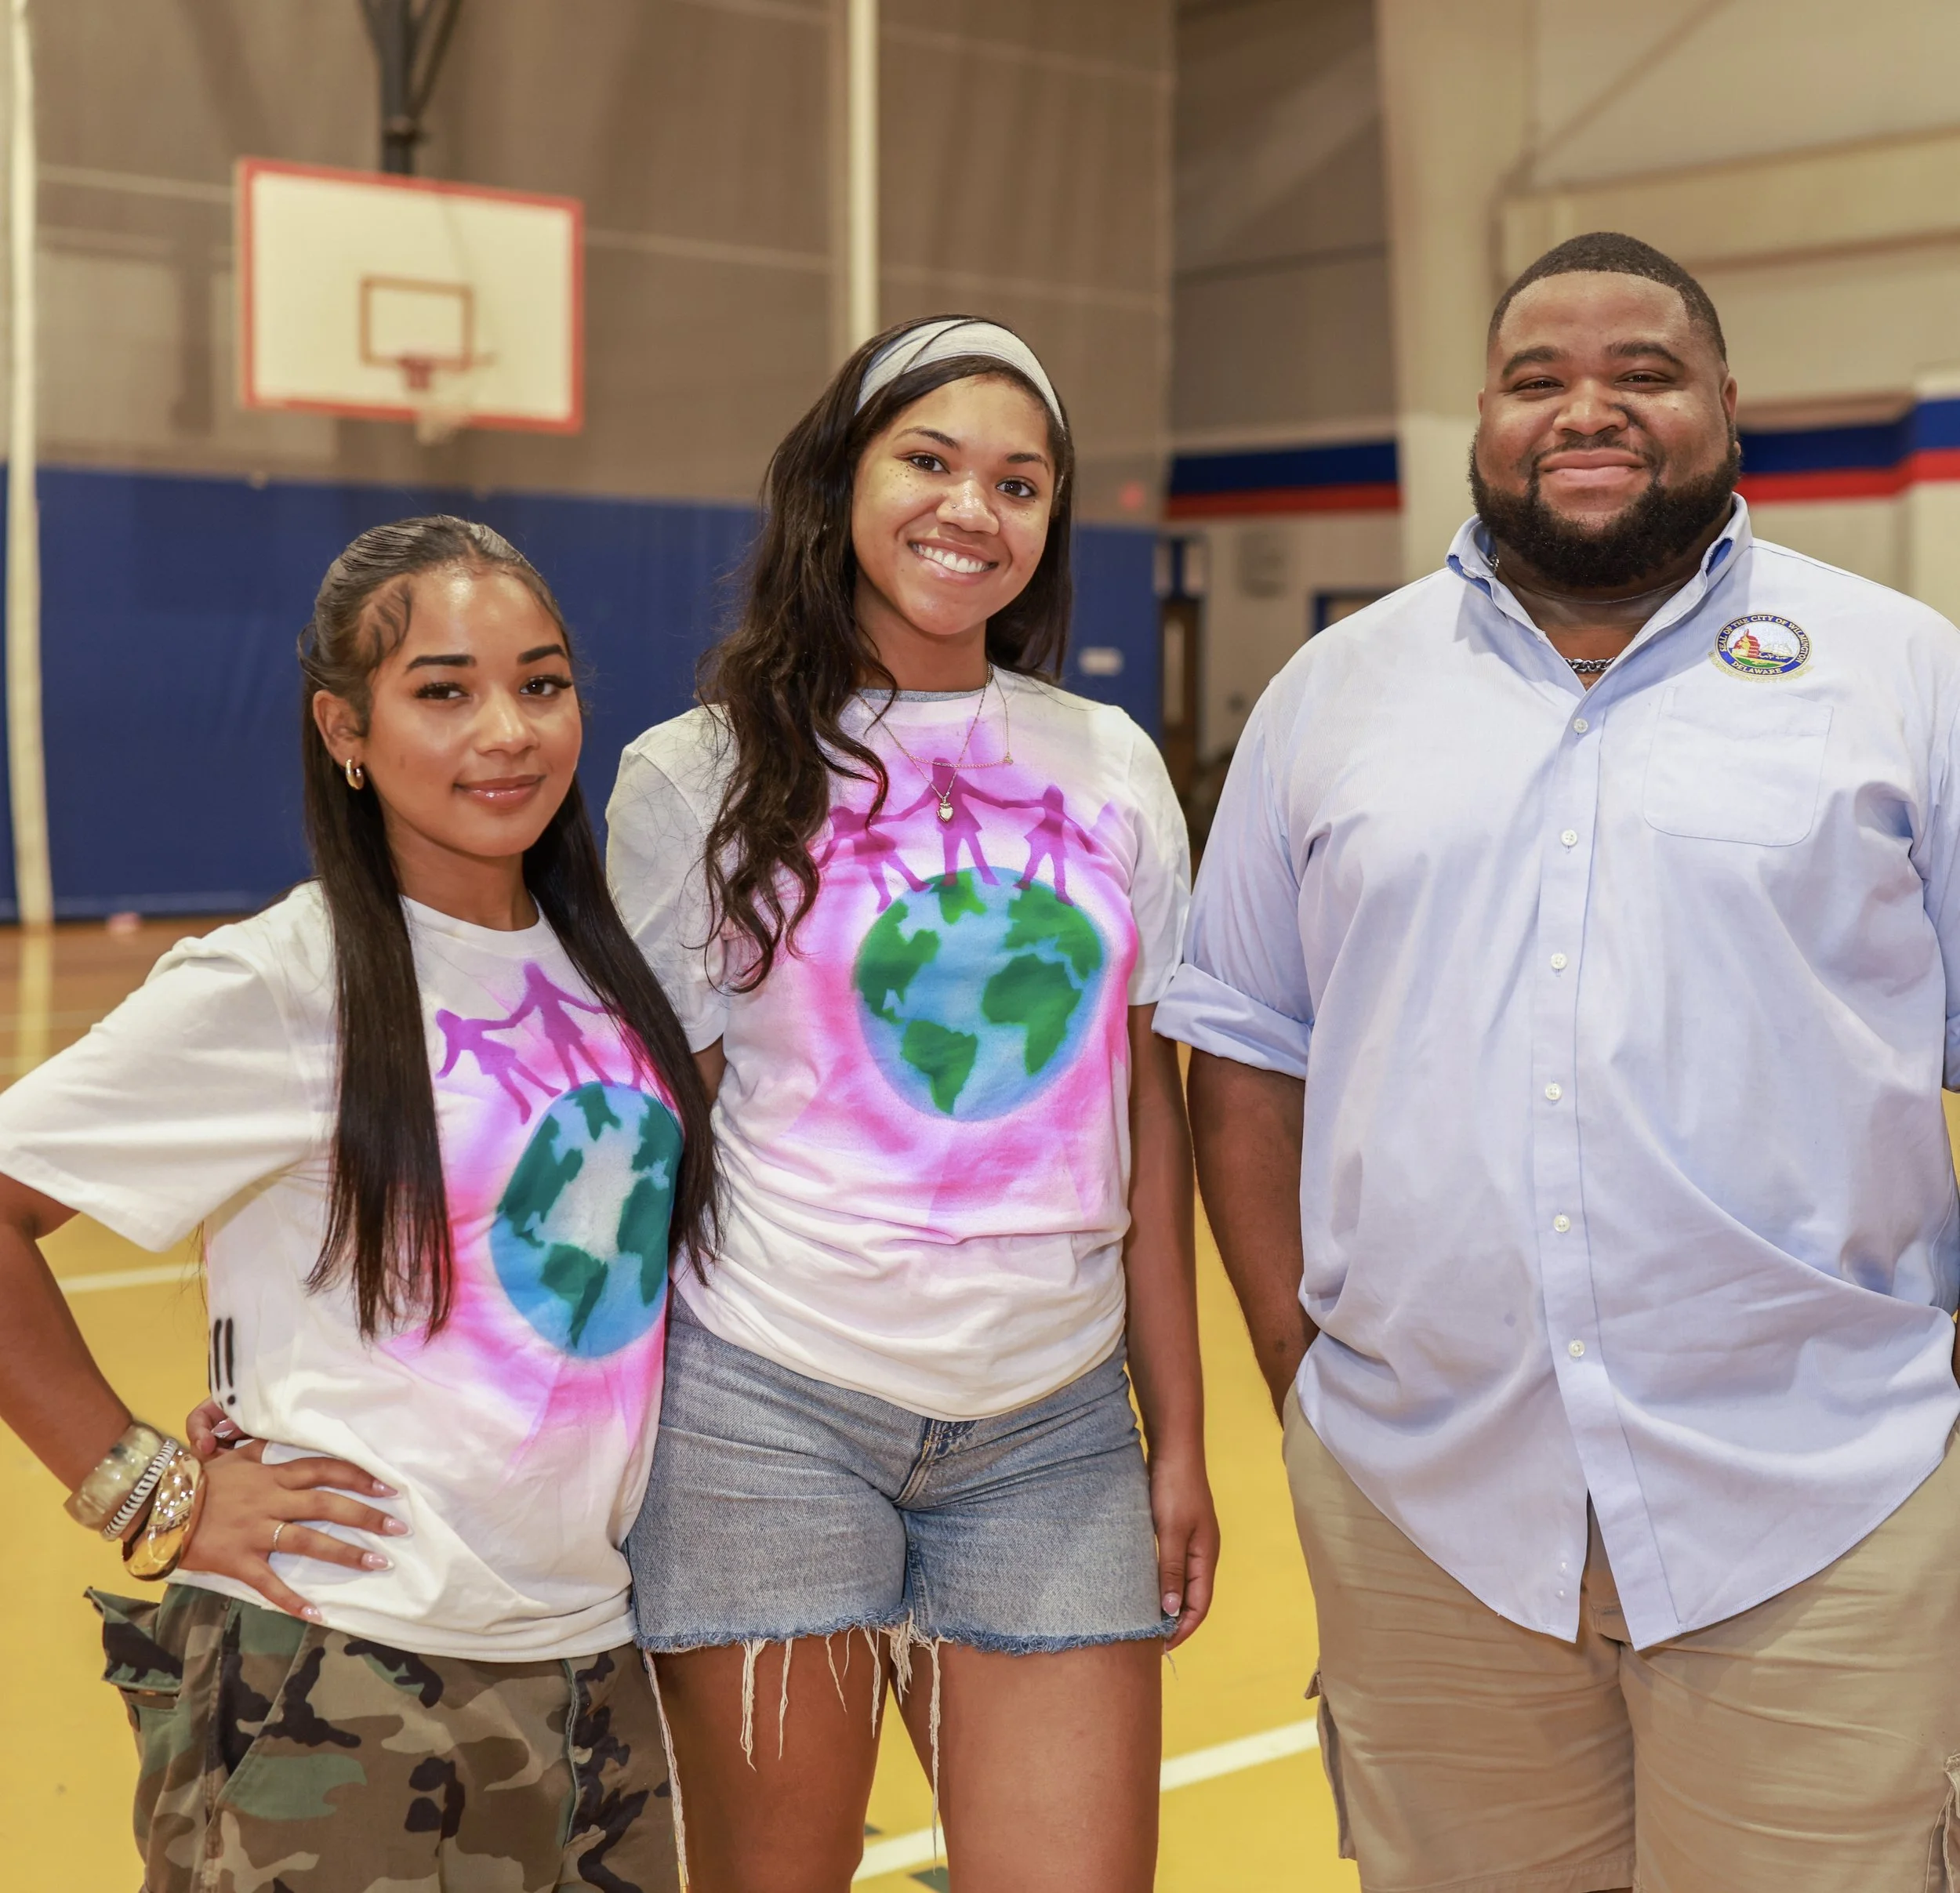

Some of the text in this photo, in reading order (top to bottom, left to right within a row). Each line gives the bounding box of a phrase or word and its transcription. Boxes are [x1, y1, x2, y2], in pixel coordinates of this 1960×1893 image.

[1725, 626, 1733, 634] OF
[1733, 618, 1749, 628] THE
[1776, 618, 1788, 626] OF
[1788, 623, 1809, 663] WILMINGTON
[1731, 662, 1783, 674] DELAWARE
